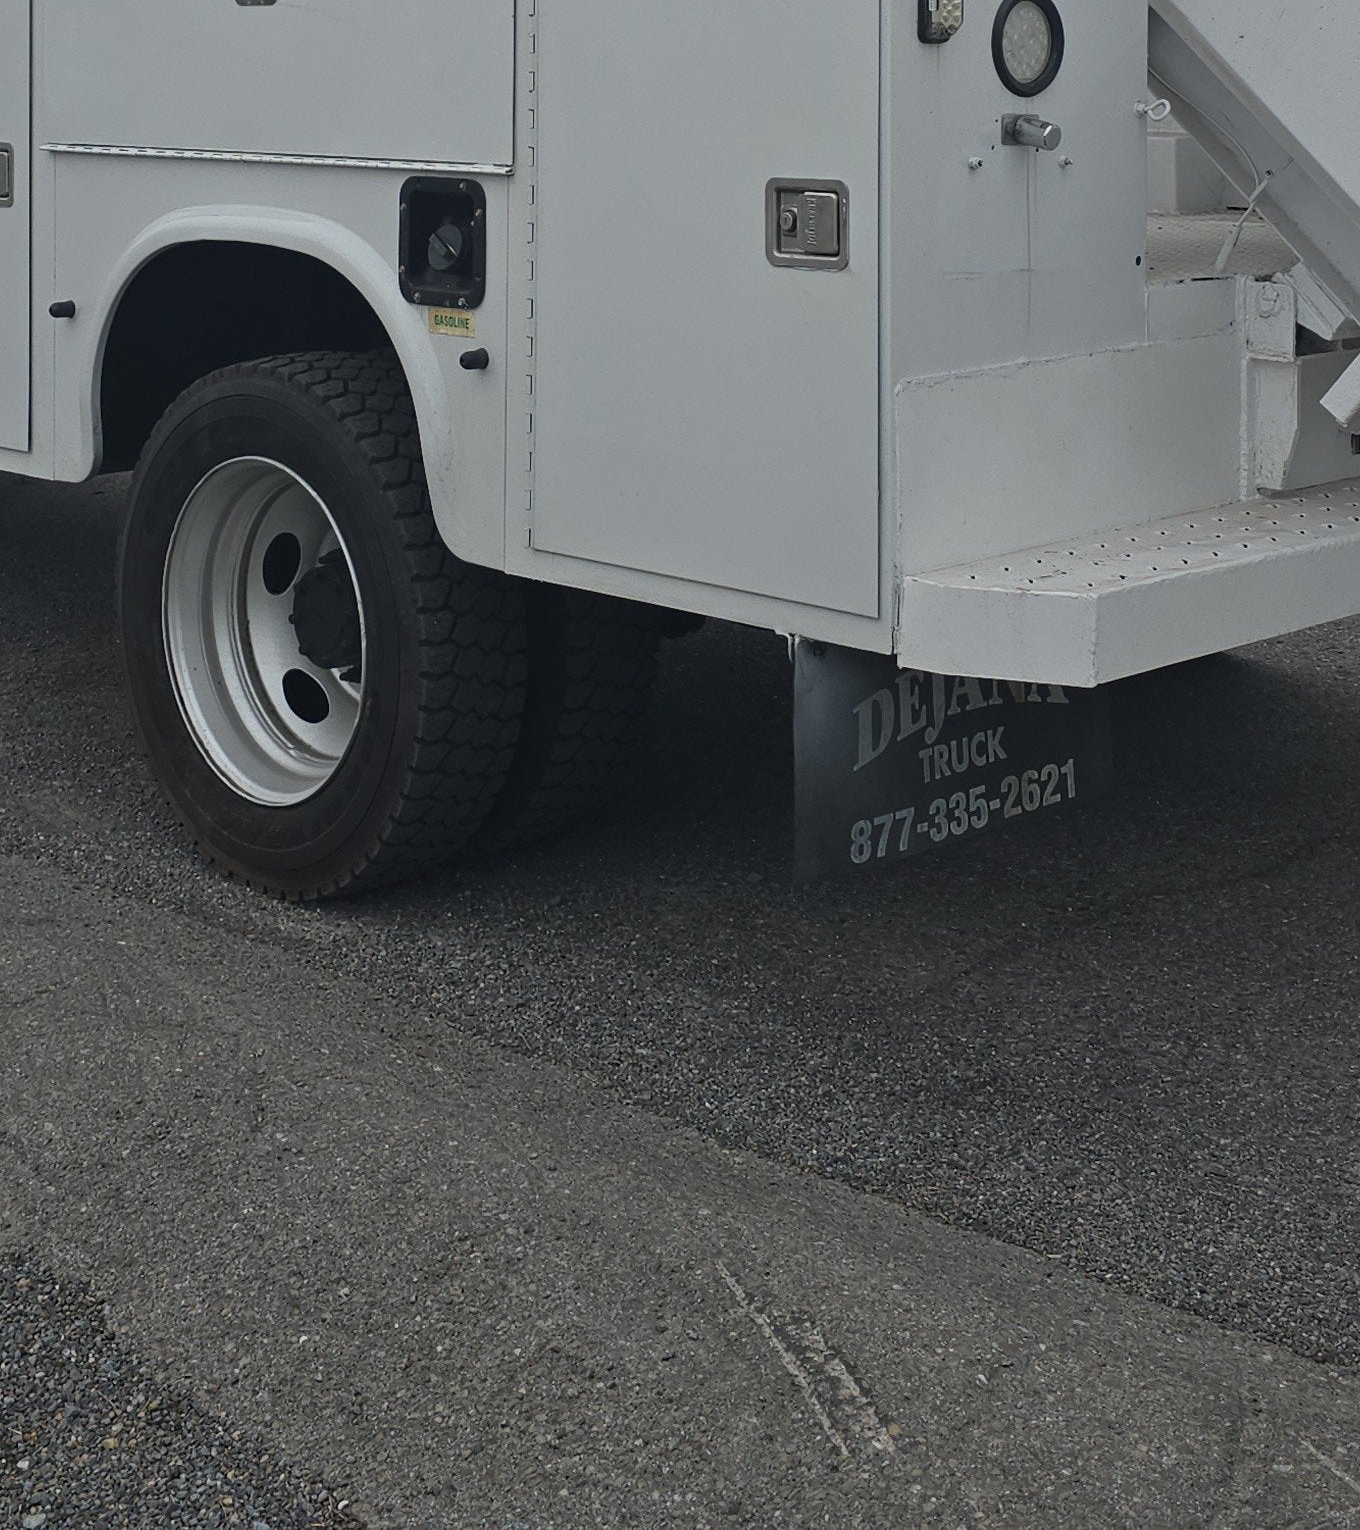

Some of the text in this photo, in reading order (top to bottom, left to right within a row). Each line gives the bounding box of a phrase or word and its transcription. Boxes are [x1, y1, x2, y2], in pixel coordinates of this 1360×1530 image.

[434, 314, 470, 329] GASOLINE
[918, 726, 1008, 784] TRUCK
[850, 758, 1077, 865] 877-335-2621
